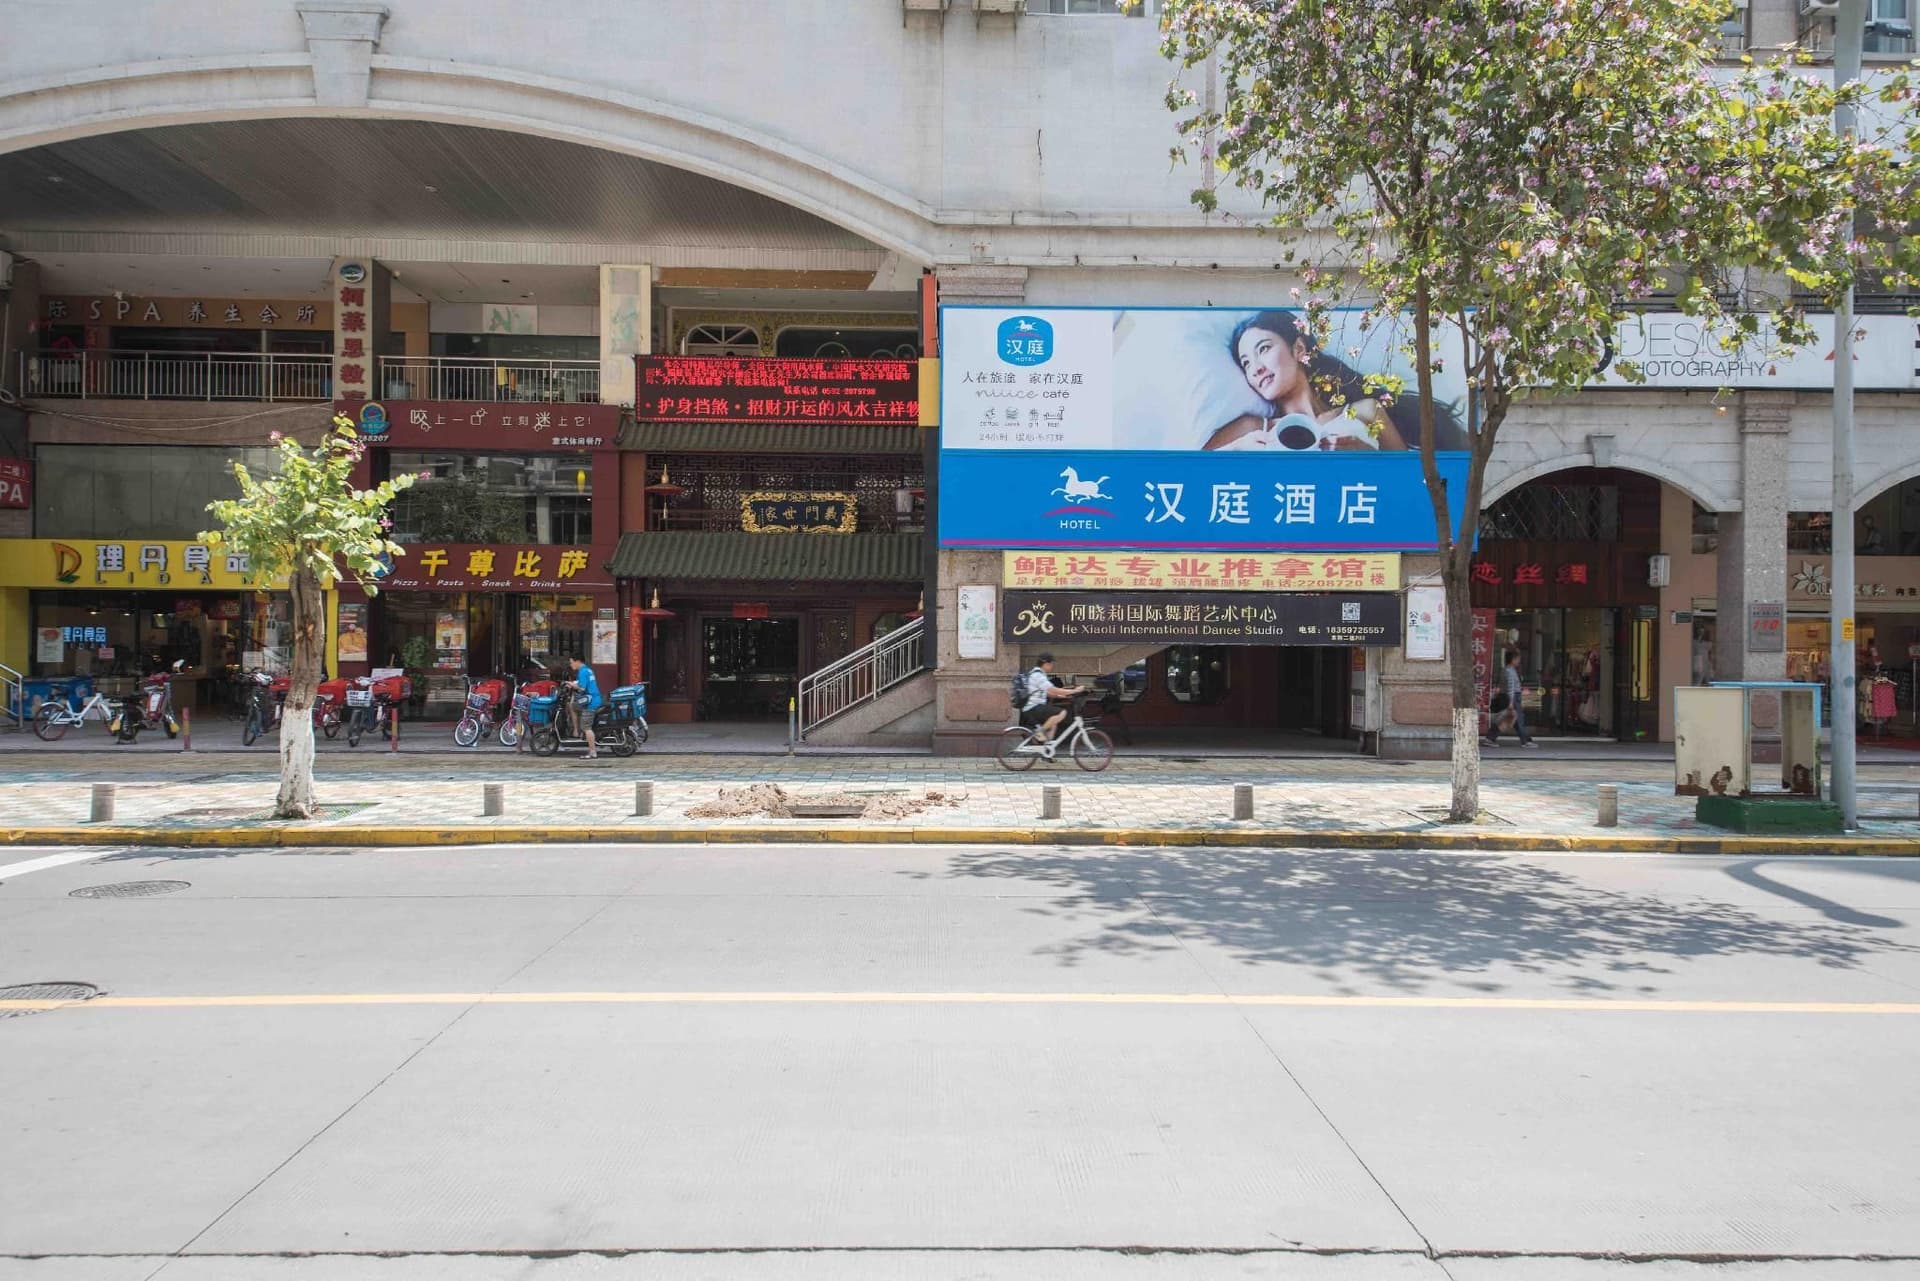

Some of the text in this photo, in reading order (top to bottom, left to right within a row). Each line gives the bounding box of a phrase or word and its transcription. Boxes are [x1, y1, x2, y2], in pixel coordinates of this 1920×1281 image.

[1006, 339, 1045, 355] 汉庭
[1620, 360, 1767, 377] HOTOGRAPHY
[962, 372, 1084, 385] 人在旅途 家在汉庭
[1145, 481, 1378, 525] 汉庭酒店
[1060, 519, 1101, 530] HOTEL
[96, 544, 251, 573] 理丹食品
[420, 549, 590, 578] 千尊比萨
[392, 579, 562, 588] Pizza Pasta Snack Drinks
[1070, 603, 1278, 622] 何晓莉国际舞蹈艺术中心
[1062, 624, 1284, 636] He Xiaoli International Dance Studio
